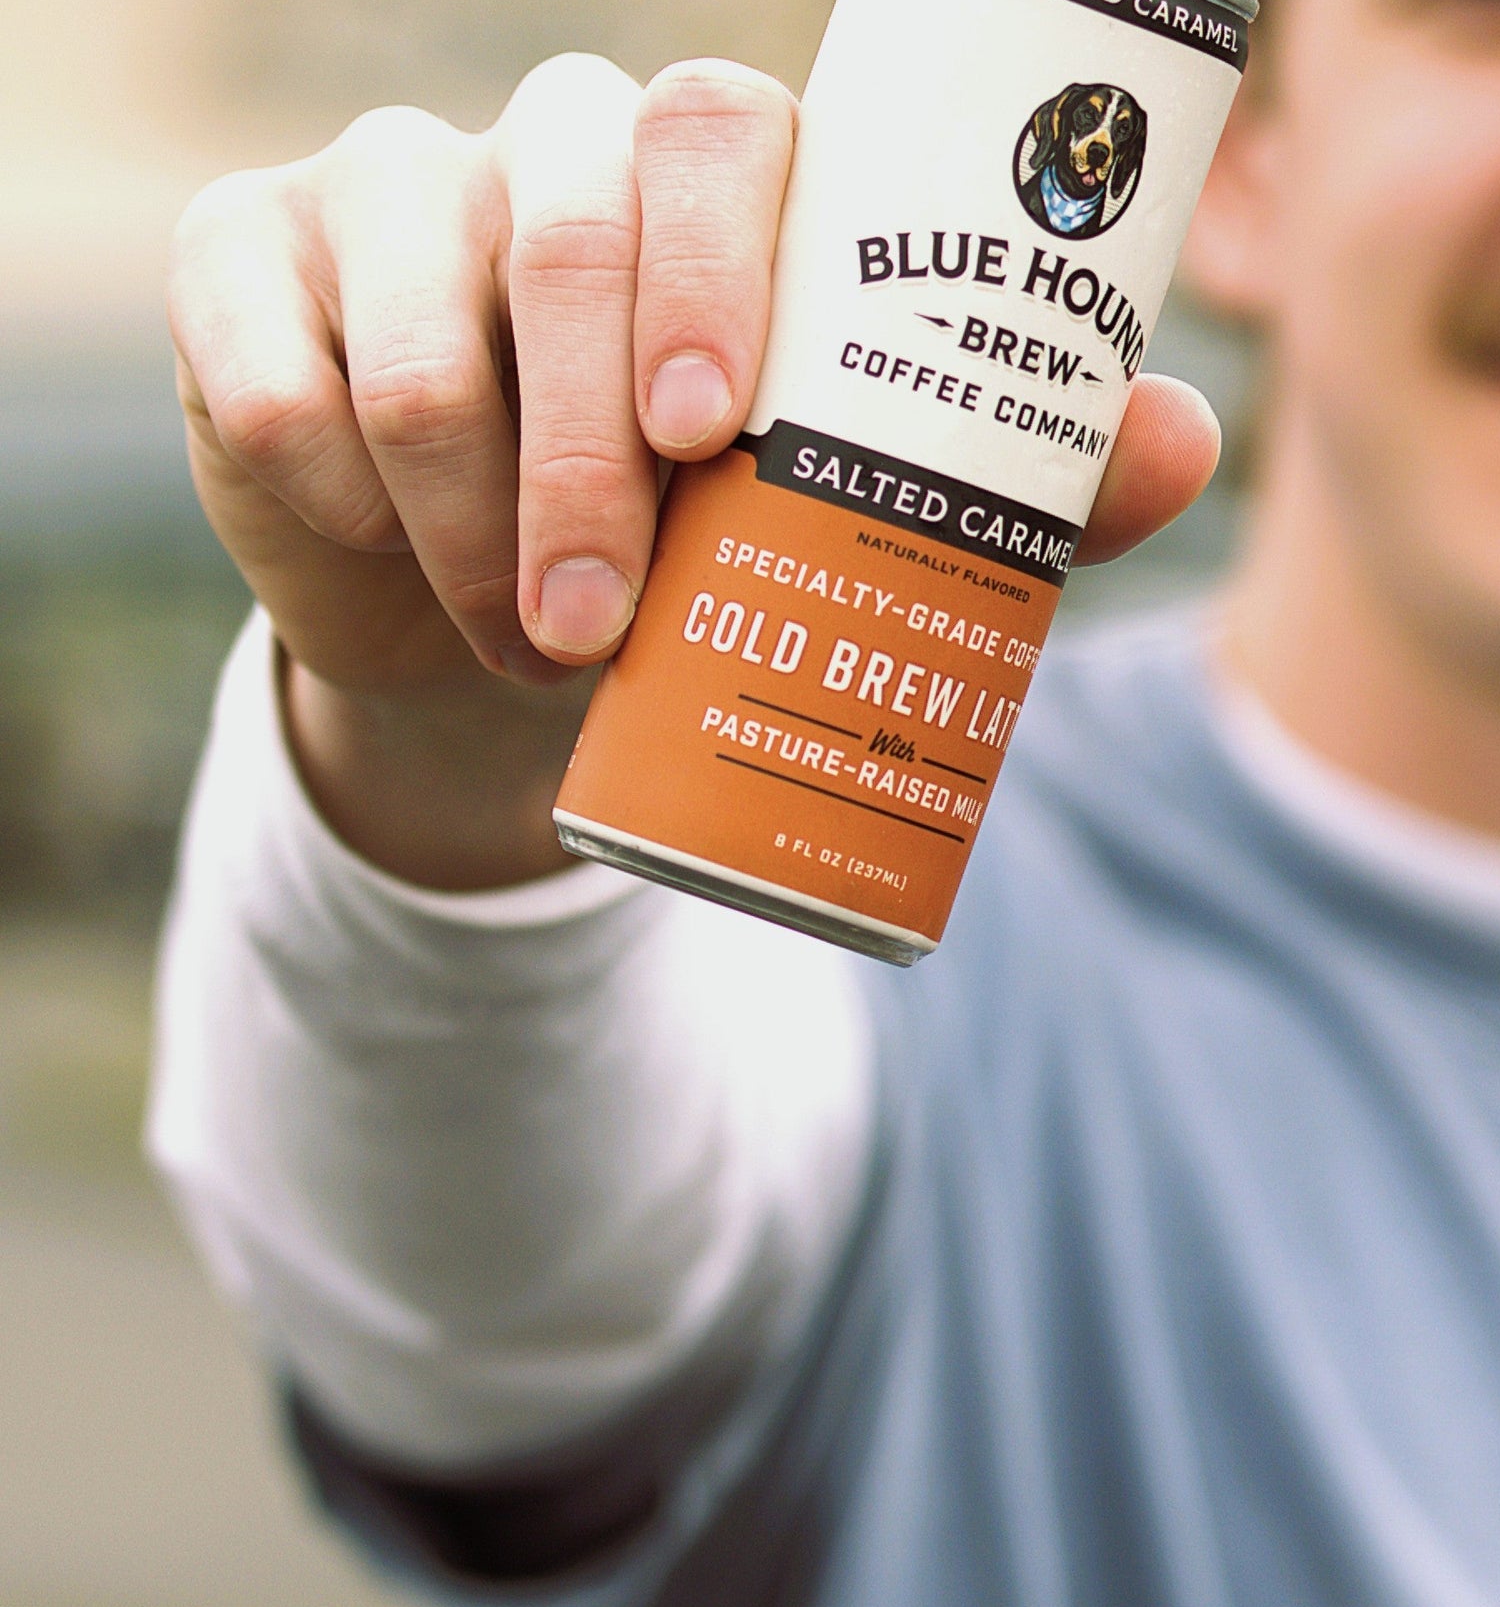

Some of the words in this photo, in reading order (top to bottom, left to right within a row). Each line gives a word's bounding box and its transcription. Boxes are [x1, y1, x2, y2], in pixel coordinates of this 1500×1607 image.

[856, 231, 1010, 286] BLUE
[1021, 246, 1145, 383] HOUND
[957, 315, 1083, 386] BREW
[840, 341, 983, 412] COFFEE
[994, 395, 1109, 461] COMPANY
[792, 447, 949, 523] SALTED
[959, 506, 1076, 574] CARAMEL
[856, 531, 960, 577] NATURALLY
[963, 569, 1030, 604] FLAVORED
[715, 537, 1001, 657] SPECIALTY-GRADE
[683, 592, 808, 675] COLD
[822, 638, 965, 729] BREW
[700, 706, 950, 814] PASTURE-RAISED
[951, 793, 983, 827] MILK
[868, 728, 915, 763] With
[774, 833, 786, 849] 8
[792, 839, 813, 858] FL
[819, 848, 843, 868] OZ
